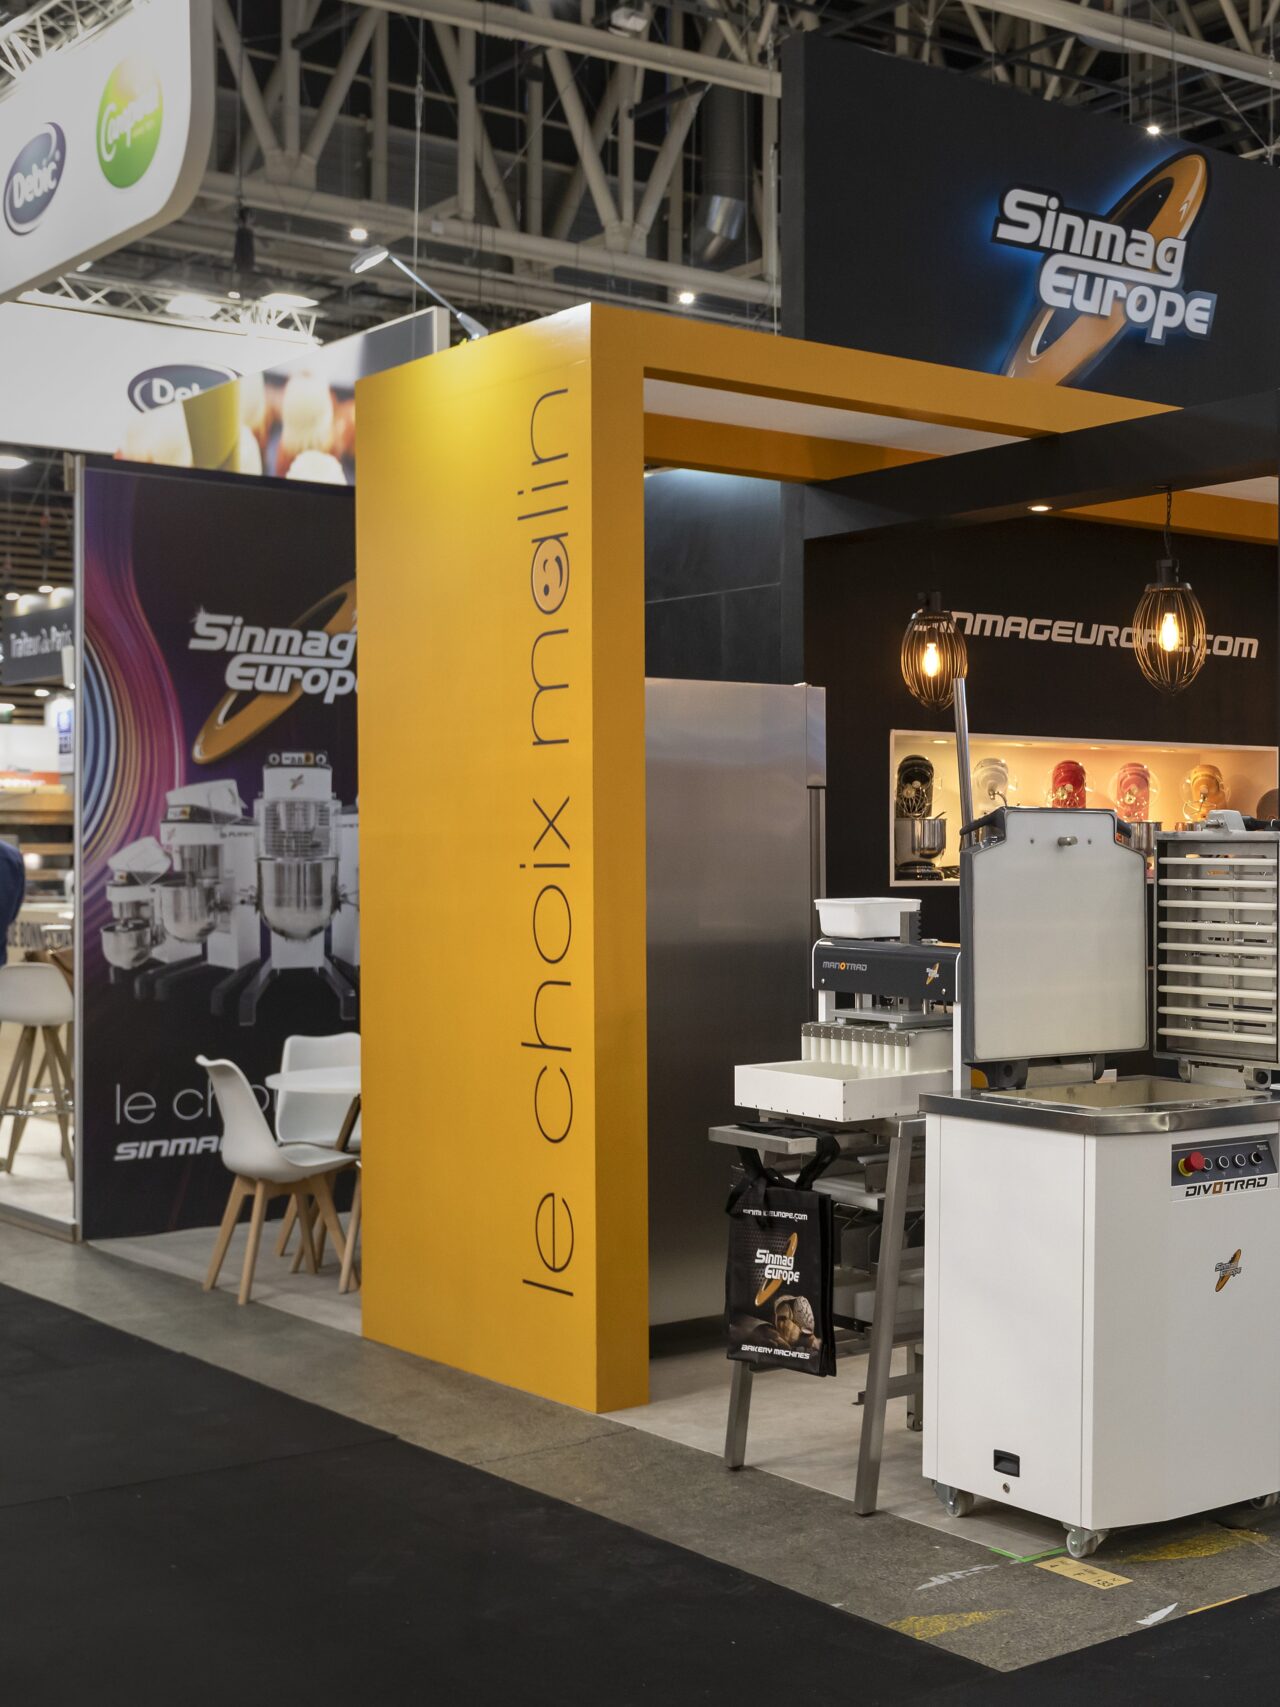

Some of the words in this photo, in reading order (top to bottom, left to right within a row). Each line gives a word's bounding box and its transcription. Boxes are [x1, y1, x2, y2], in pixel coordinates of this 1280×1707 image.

[13, 158, 58, 208] Debic
[996, 188, 1187, 288] Sinmag
[1039, 253, 1213, 339] Europe
[517, 388, 570, 746] malin
[188, 610, 357, 669] Sinmag
[225, 653, 357, 704] Europ
[519, 796, 573, 1143] choix
[822, 961, 868, 972] MANOTRAD
[115, 1082, 157, 1126] le
[1185, 1176, 1268, 1198] DIVOTRAD
[522, 1192, 574, 1297] le
[754, 1248, 795, 1271] Sinmag
[765, 1265, 800, 1285] Europe
[741, 1344, 773, 1355] BAKERY
[773, 1348, 811, 1360] MACHINES
